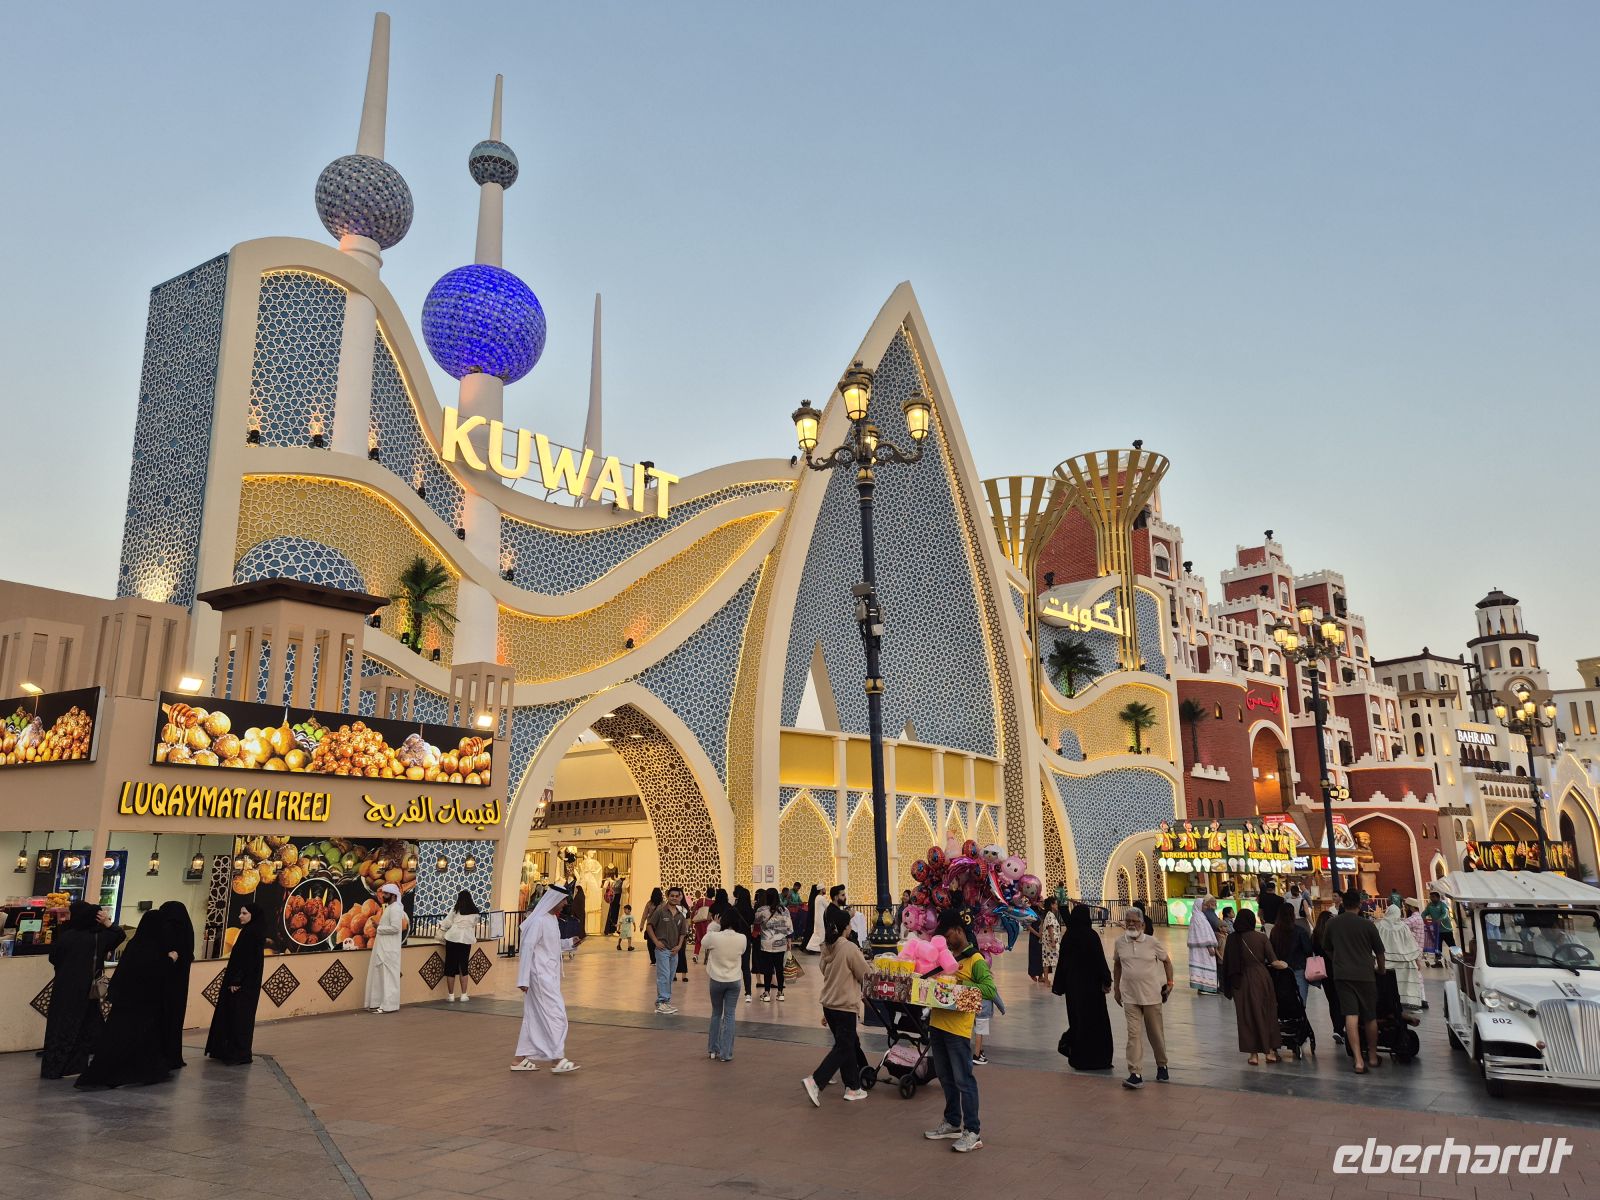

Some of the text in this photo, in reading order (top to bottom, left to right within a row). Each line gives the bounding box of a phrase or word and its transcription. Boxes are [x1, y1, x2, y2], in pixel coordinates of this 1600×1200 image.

[442, 406, 679, 519] KUWAIT
[1042, 597, 1131, 637] الكويت
[1457, 730, 1496, 745] BAHRAIN
[119, 781, 331, 822] LUQAYMAT AL FREEJ
[363, 794, 500, 831] لقيمات الفريج
[1161, 851, 1222, 859] TURKISH ICE CREAM
[1491, 1017, 1513, 1025] 802
